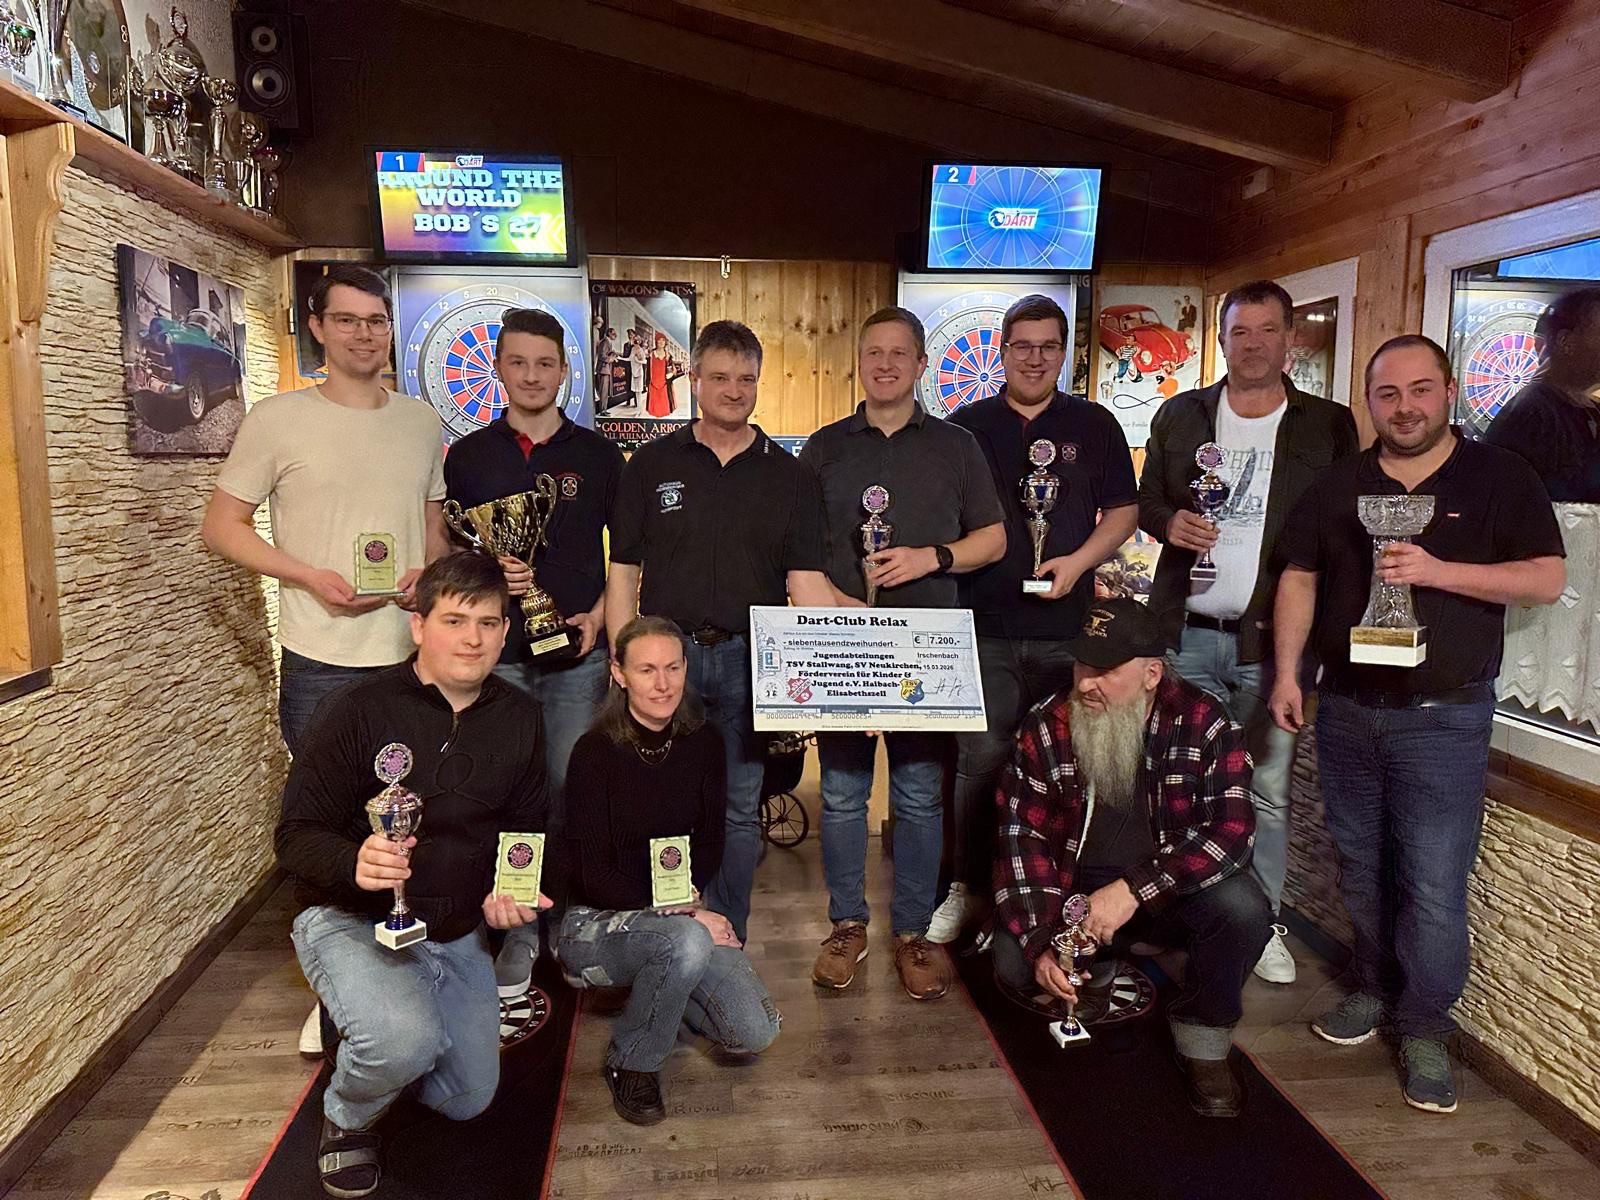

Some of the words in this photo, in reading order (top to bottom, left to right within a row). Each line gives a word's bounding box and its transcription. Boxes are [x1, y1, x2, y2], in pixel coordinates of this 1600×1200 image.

[396, 155, 405, 171] 1
[501, 169, 562, 188] THE
[948, 166, 959, 183] 2
[416, 188, 522, 208] WORLD
[1003, 214, 1036, 227] DART
[486, 288, 498, 296] 20
[607, 284, 659, 295] WAGONS
[463, 291, 470, 299] 5
[439, 302, 449, 310] 12
[423, 321, 430, 329] 9
[409, 344, 421, 352] 14
[568, 346, 578, 354] 13
[407, 369, 417, 377] 11
[575, 371, 581, 379] 6
[601, 422, 647, 433] GOLDEN
[603, 432, 618, 440] ALL
[619, 432, 657, 440] PULLMAN
[796, 615, 867, 626] Dart-Club
[869, 616, 908, 627] Relax
[788, 639, 894, 648] siebentausendzweihundert
[914, 635, 921, 644] €
[929, 636, 960, 646] 7.200,-
[812, 652, 895, 661] Jugendabteilungen
[917, 652, 959, 660] Irschenbach
[806, 661, 854, 669] Stallwang,
[869, 661, 922, 670] Neukirchen,
[797, 670, 855, 678] Förderverein
[811, 680, 844, 688] Jugend
[826, 689, 887, 697] Elisabethszell
